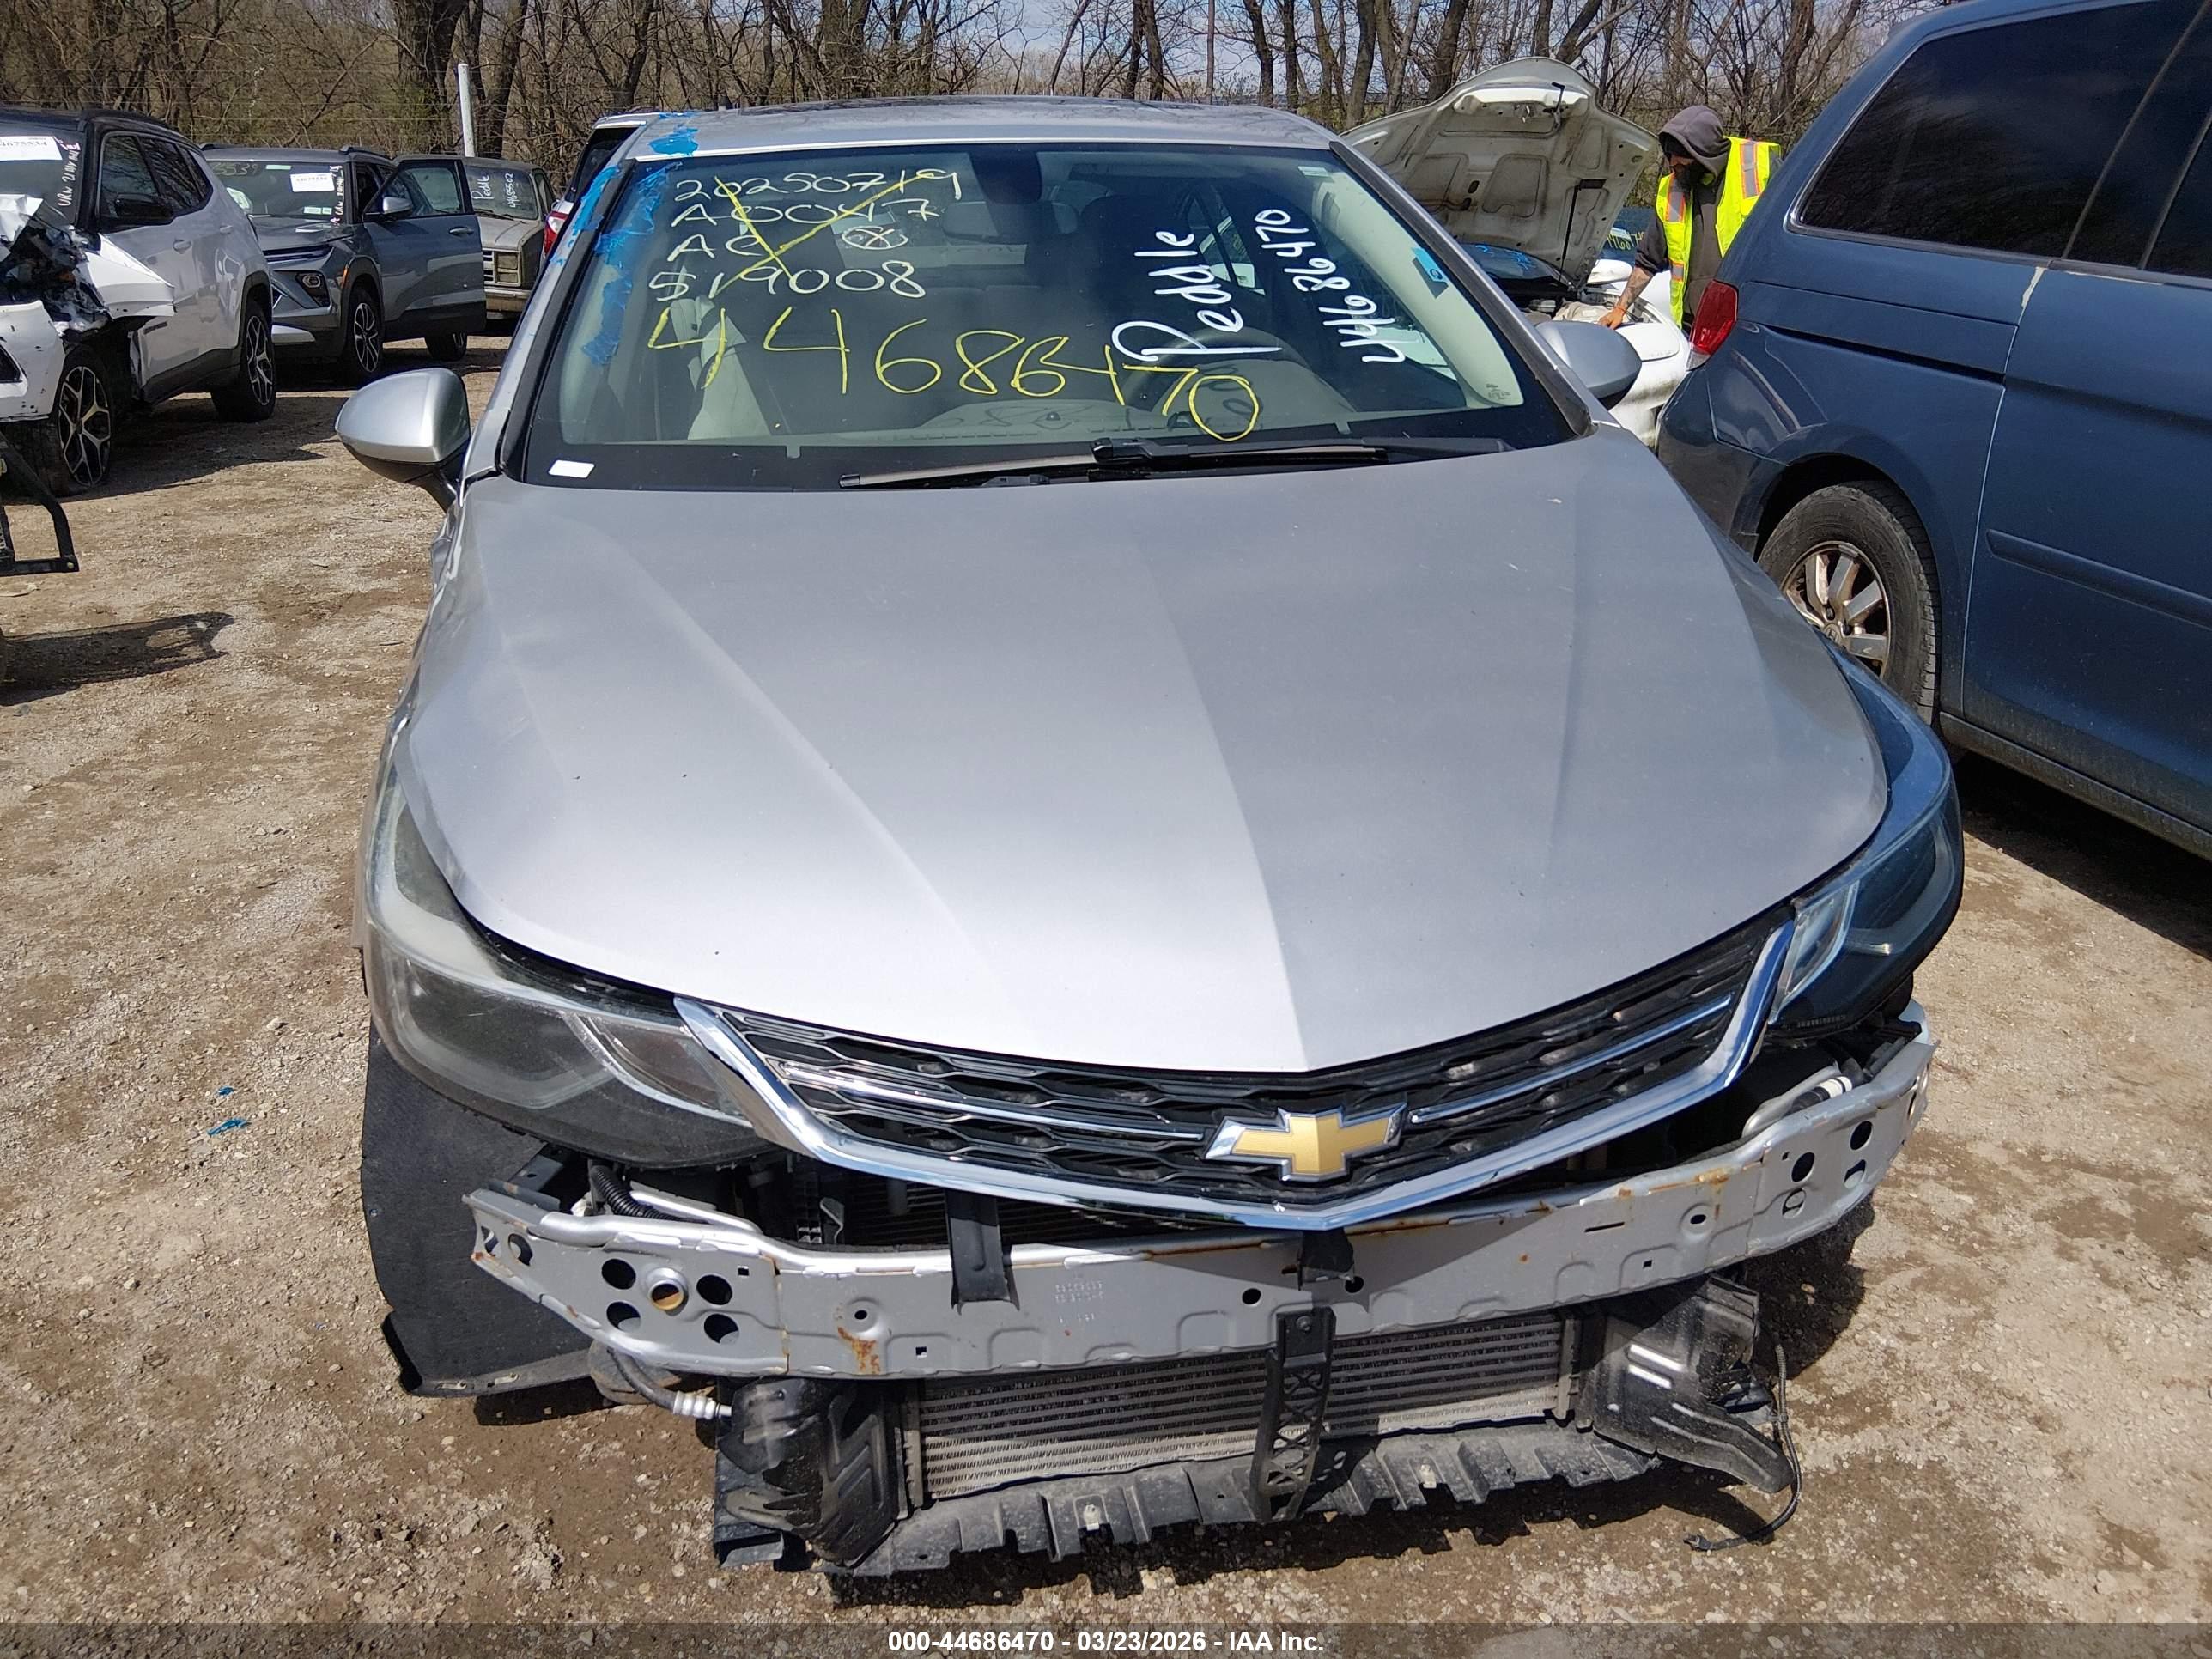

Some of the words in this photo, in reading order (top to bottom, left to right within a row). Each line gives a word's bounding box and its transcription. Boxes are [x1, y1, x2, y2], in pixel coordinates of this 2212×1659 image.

[471, 174, 495, 200] Peddle
[671, 198, 941, 228] A0047
[674, 169, 963, 200] 20250719
[1111, 231, 1284, 362] Peddle
[1254, 209, 1420, 362] 44686470
[647, 307, 1260, 441] 44686470
